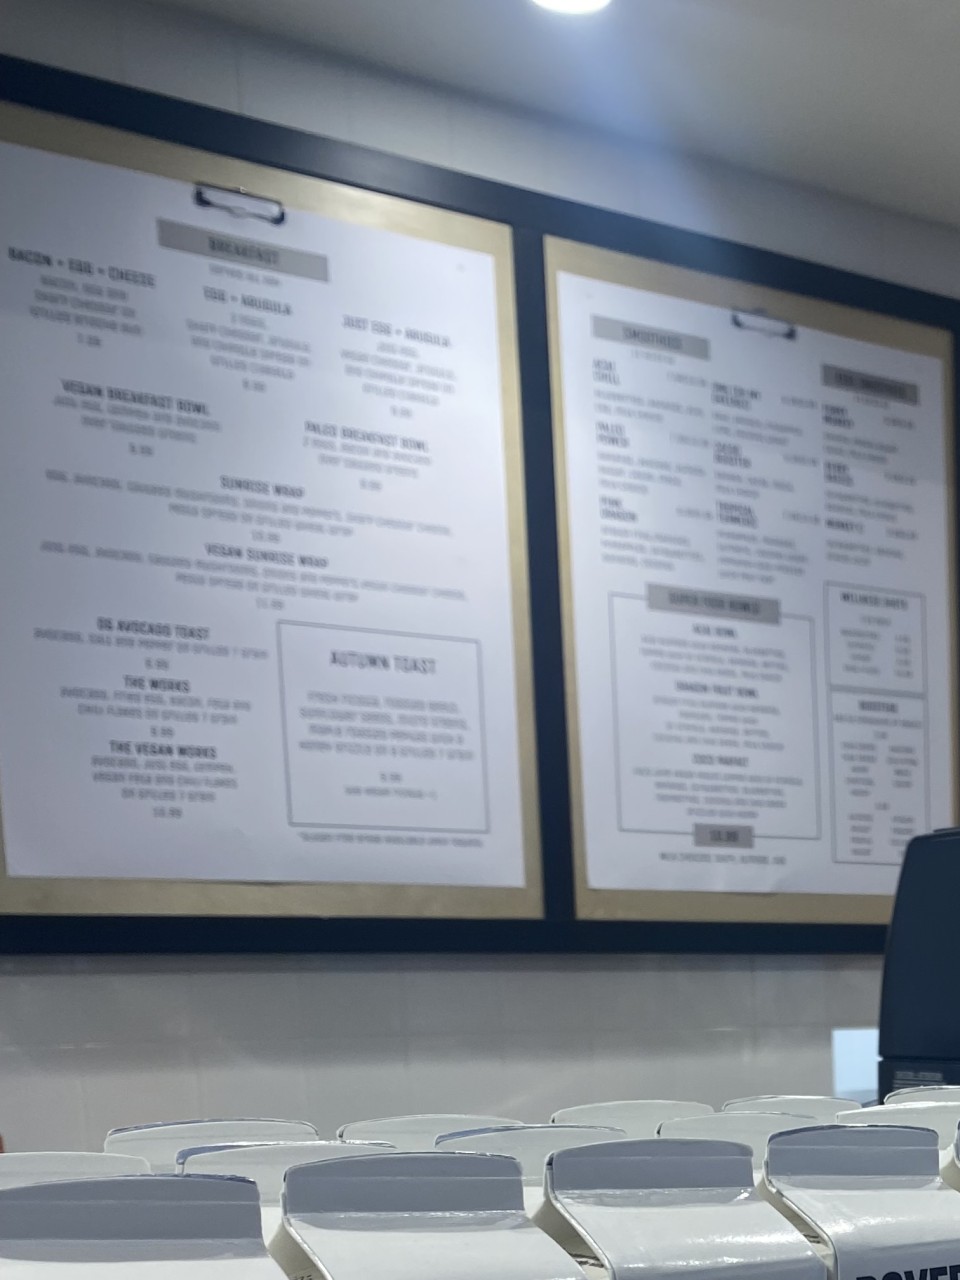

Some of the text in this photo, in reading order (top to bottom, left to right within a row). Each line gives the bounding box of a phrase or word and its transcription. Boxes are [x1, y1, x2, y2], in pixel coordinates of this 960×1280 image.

[61, 378, 210, 416] VEGAN BREAKFAST BOWL
[220, 475, 305, 498] SUNRISE WRAP
[204, 542, 328, 568] VEGAN SUNRISE WRAP
[330, 650, 436, 675] AUTUMN TOAST
[123, 674, 191, 693] THE WORKS
[109, 740, 217, 760] THE VEGAN WORKS
